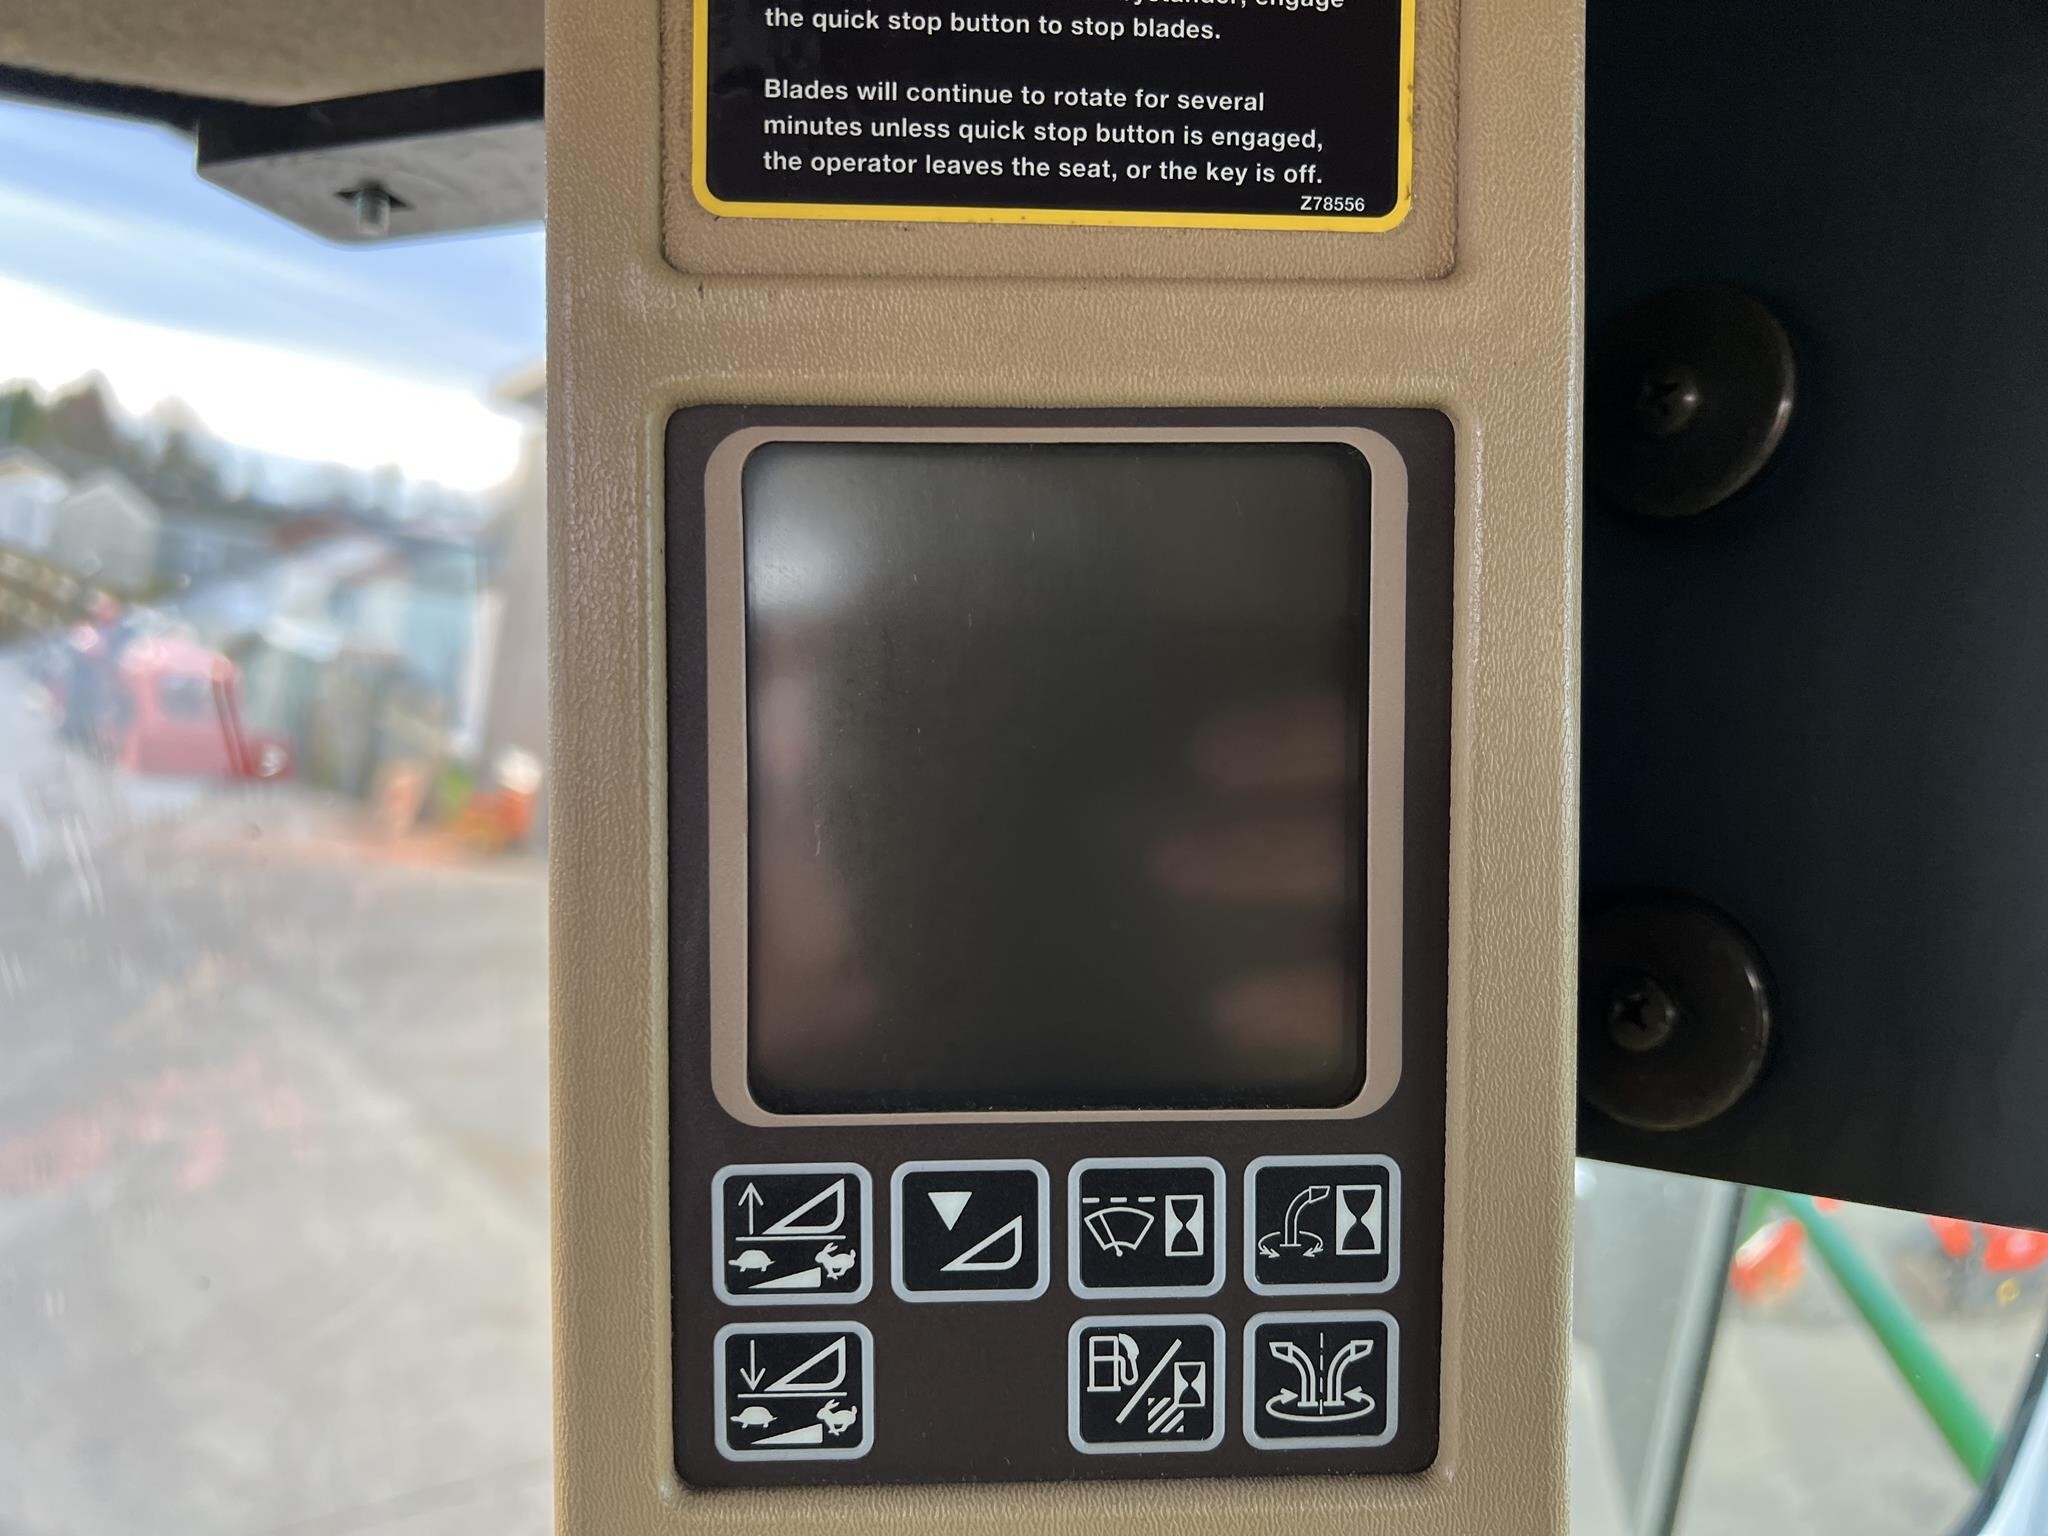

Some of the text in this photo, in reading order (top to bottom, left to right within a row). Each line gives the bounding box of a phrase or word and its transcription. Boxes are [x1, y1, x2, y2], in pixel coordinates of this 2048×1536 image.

[765, 8, 1221, 41] the quick stop button to stop blades.
[764, 78, 1264, 112] Blades will continue to rotate for several
[763, 115, 1323, 153] minutes unless quick stop button is engaged,
[763, 151, 1322, 186] the operator leaves the seat, or the key is off.
[1300, 196, 1365, 212] Z78556
